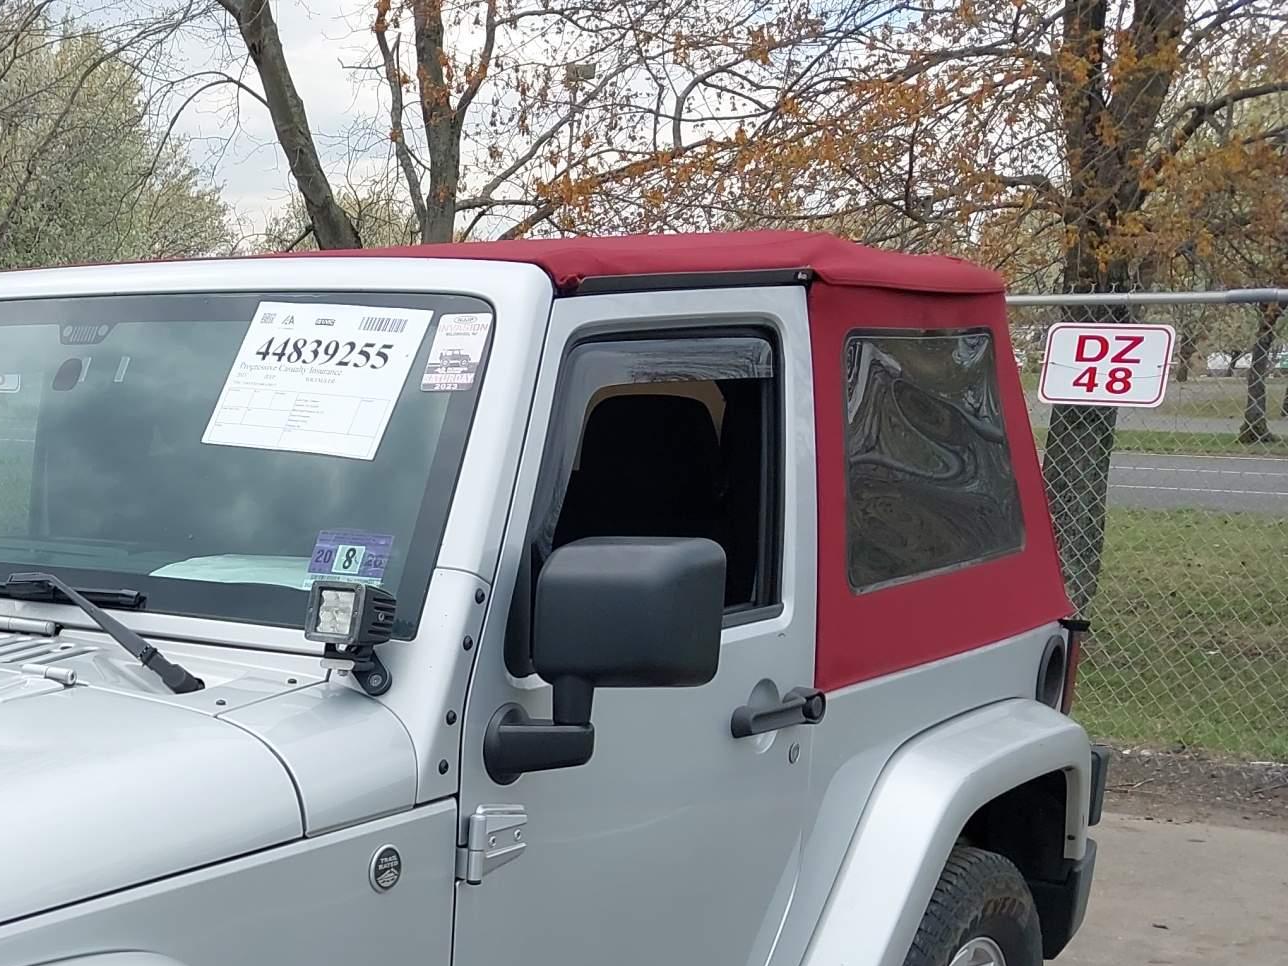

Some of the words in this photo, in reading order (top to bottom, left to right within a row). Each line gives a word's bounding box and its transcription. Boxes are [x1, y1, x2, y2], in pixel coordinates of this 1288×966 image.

[255, 336, 394, 370] 44839255
[1075, 335, 1144, 364] DZ
[1072, 366, 1133, 395] 48
[314, 549, 333, 564] 20
[342, 547, 357, 570] 8
